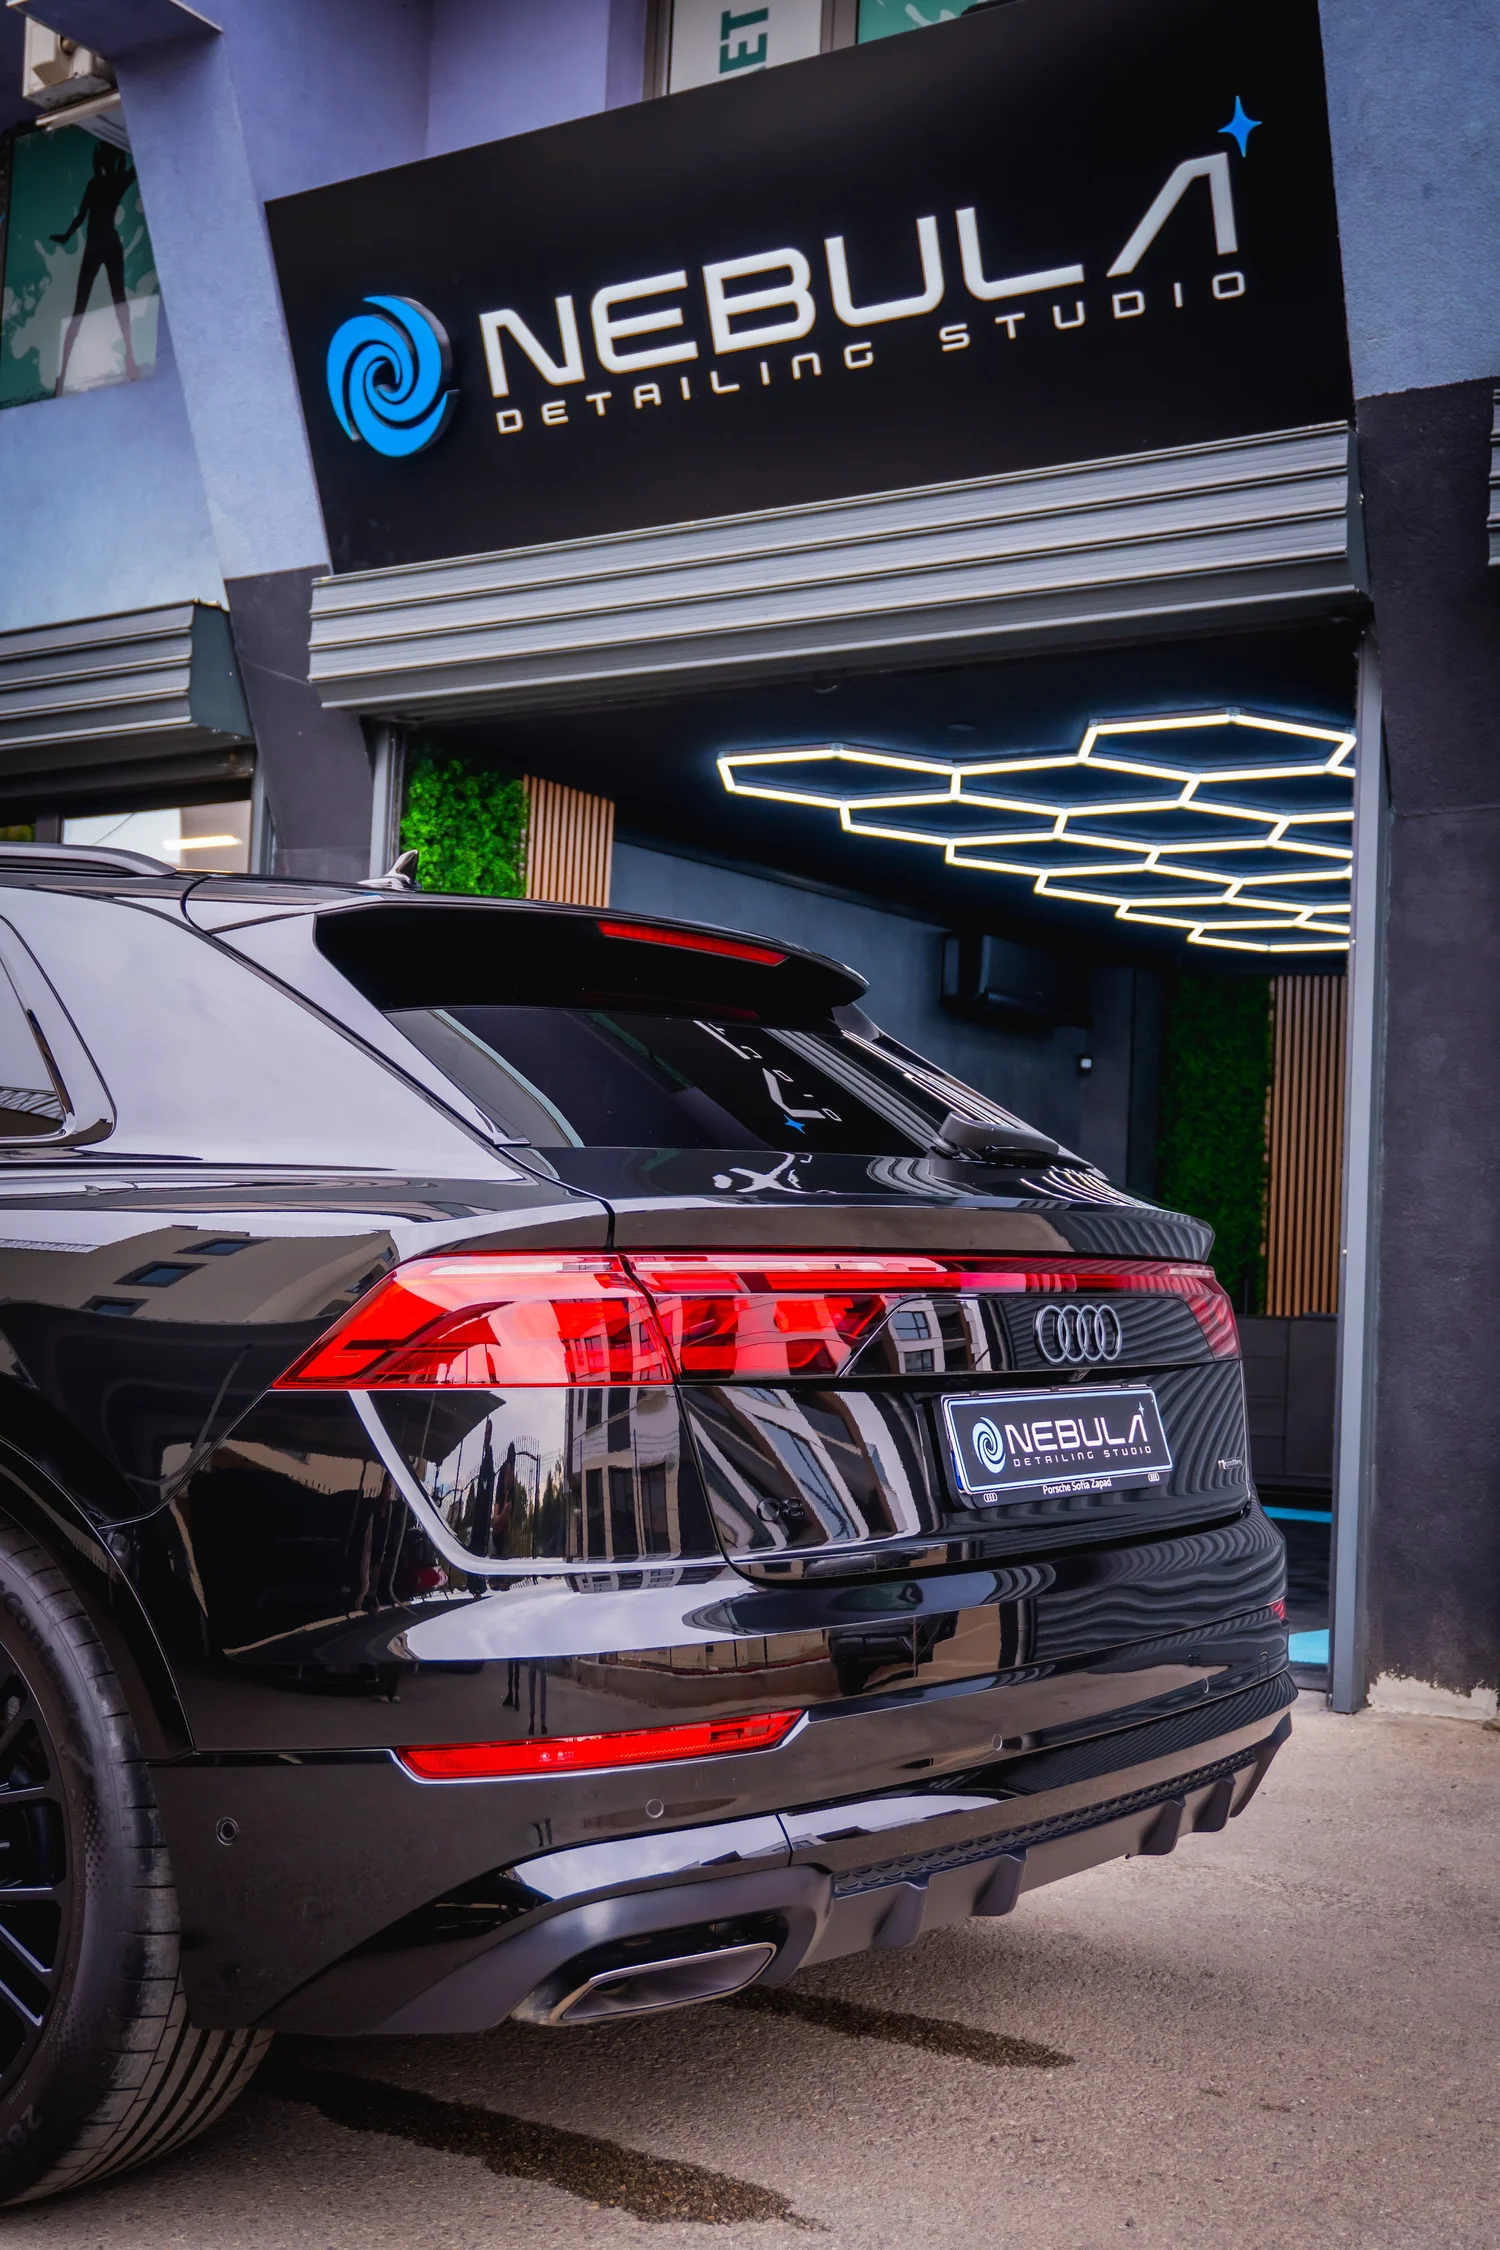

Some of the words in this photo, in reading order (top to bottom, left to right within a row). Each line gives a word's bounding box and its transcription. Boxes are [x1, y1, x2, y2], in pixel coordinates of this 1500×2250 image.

[719, 7, 769, 74] ET
[479, 152, 1238, 398] NEBULA
[496, 341, 874, 434] DETAILING
[938, 271, 1246, 352] STUDIO
[1004, 1414, 1149, 1455] NEBULA
[1013, 1450, 1095, 1468] DETAILING
[1104, 1445, 1152, 1458] STUDIO
[1042, 1482, 1072, 1495] Porsche
[1071, 1480, 1091, 1492] Sofia
[1091, 1477, 1113, 1490] Zapad
[756, 1496, 806, 1524] Q8
